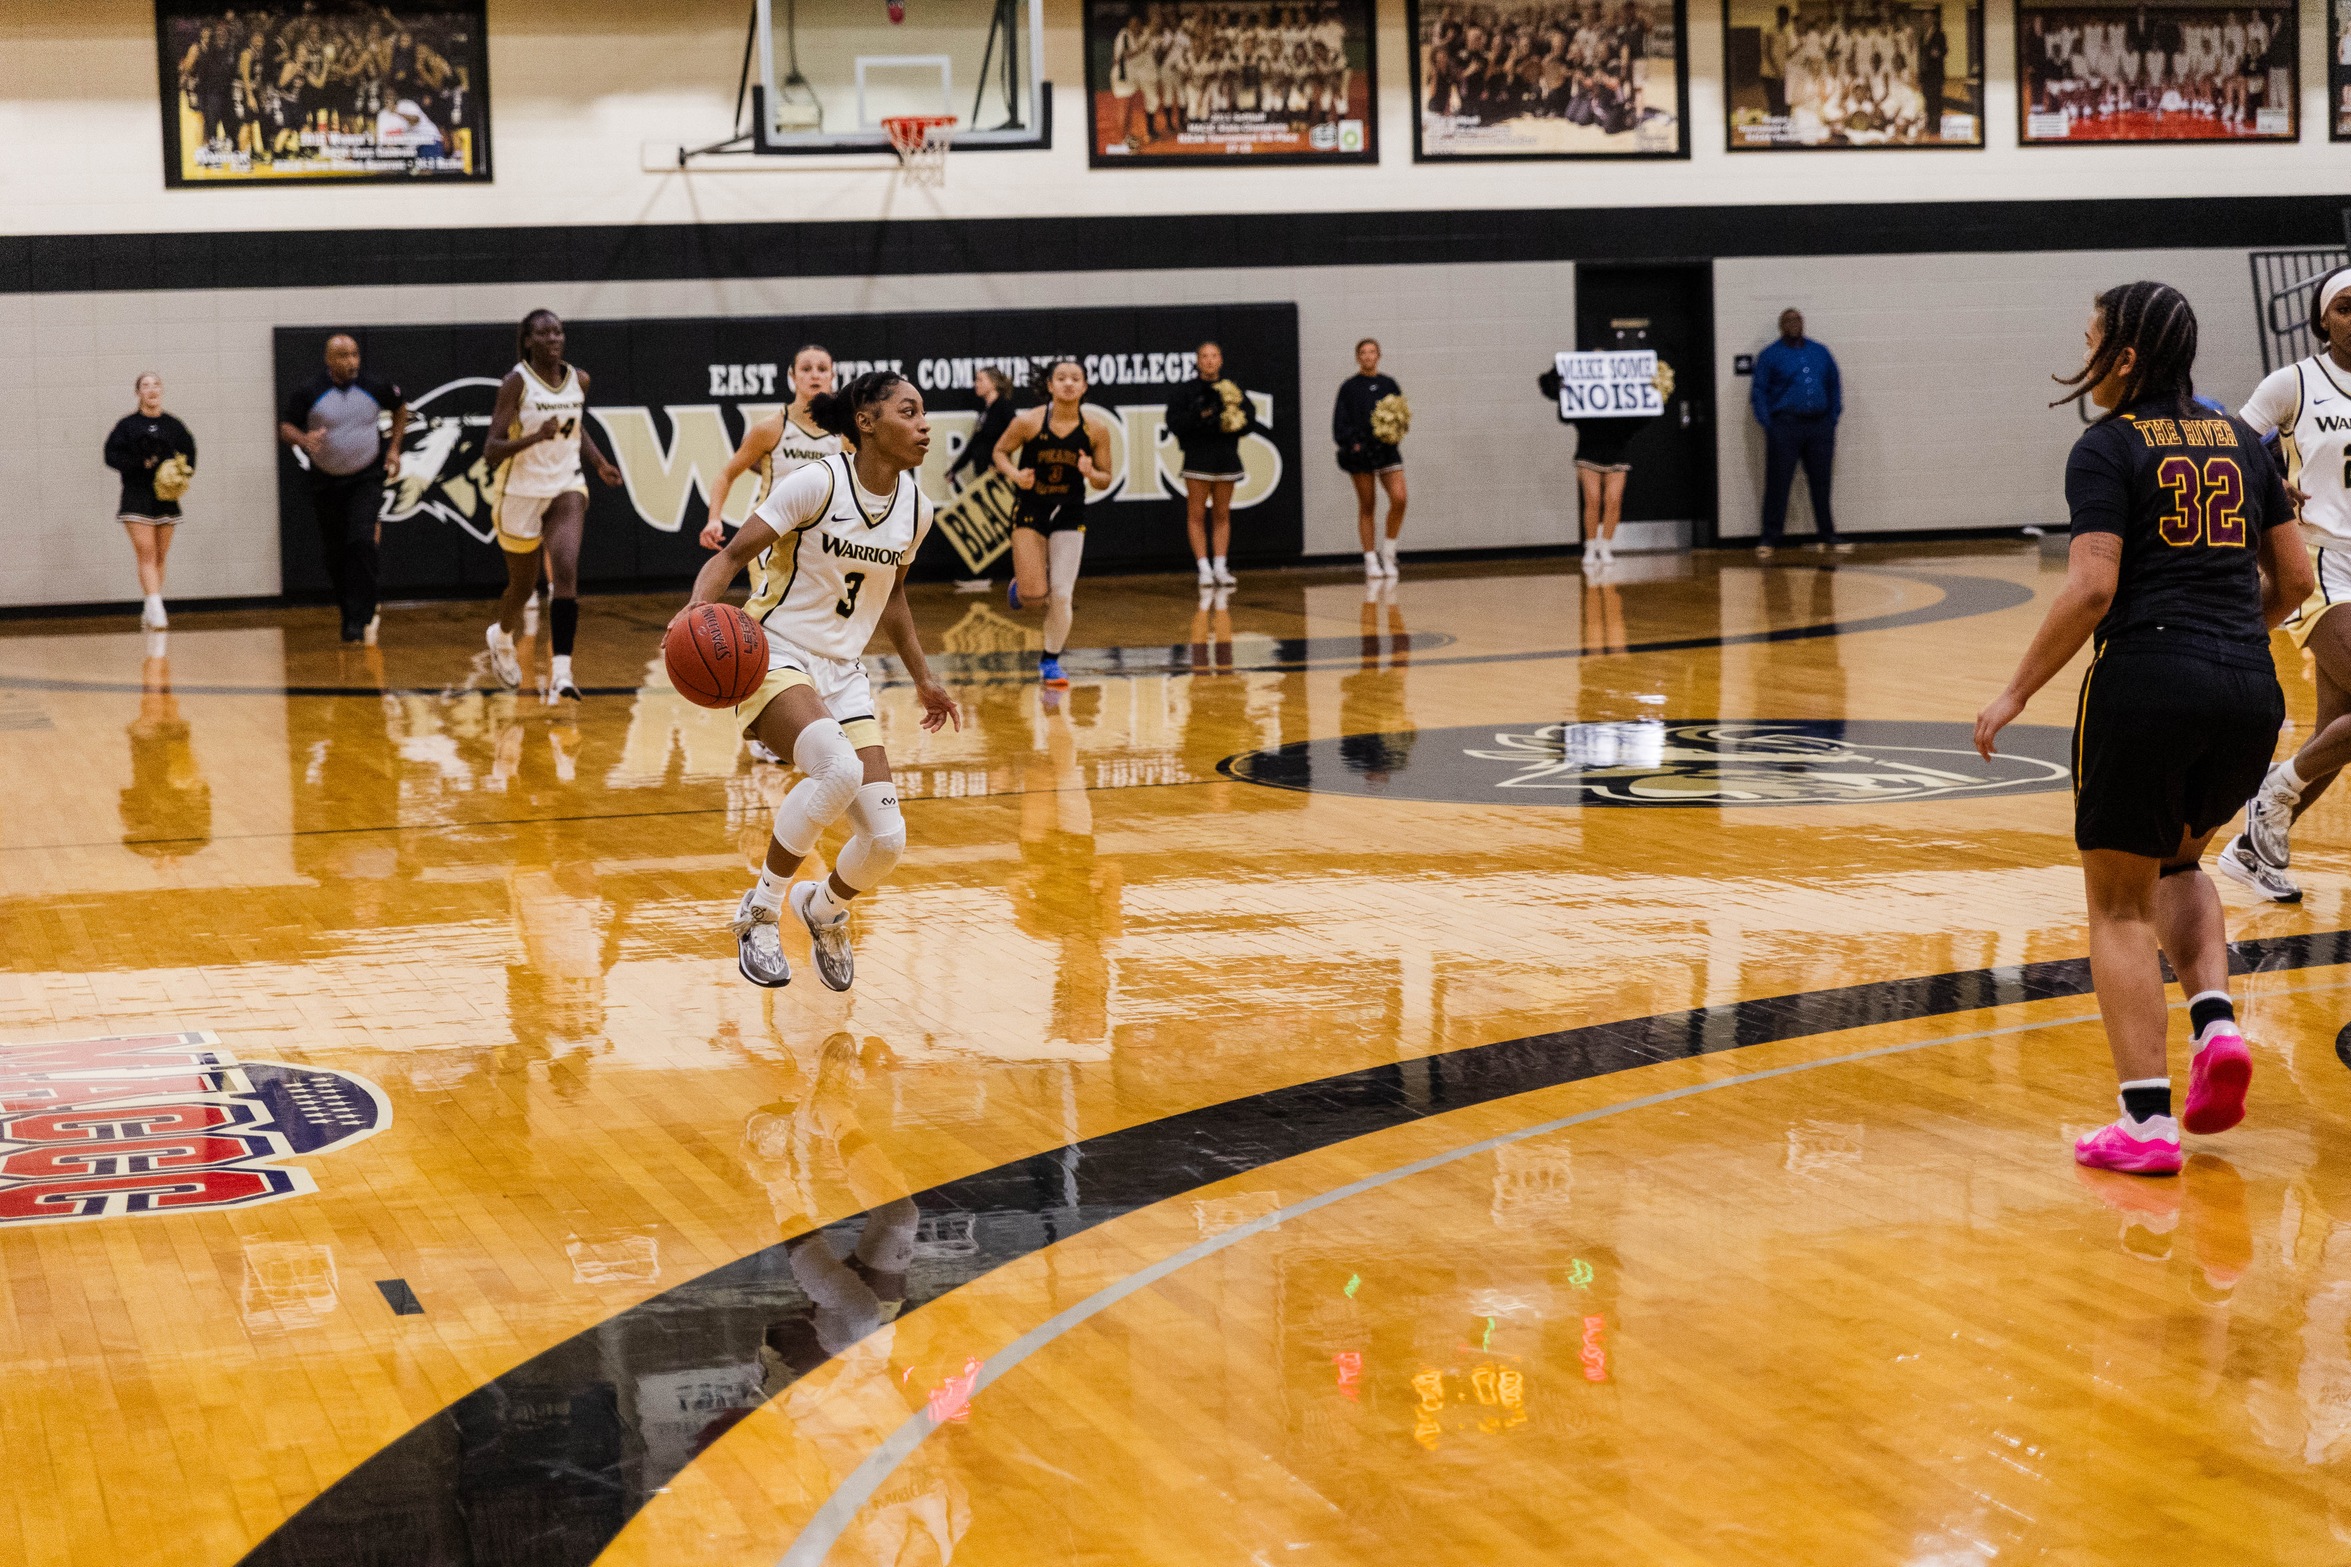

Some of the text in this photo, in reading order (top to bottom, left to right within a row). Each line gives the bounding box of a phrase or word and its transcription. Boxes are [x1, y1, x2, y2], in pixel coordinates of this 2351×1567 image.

[708, 362, 778, 397] EAST
[1084, 352, 1199, 386] COLLEGE
[1562, 356, 1653, 380] MAKE SOME
[1567, 382, 1658, 411] NOISE
[2132, 418, 2239, 447] THE RIVER
[2314, 415, 2351, 433] WA
[2156, 456, 2247, 548] 32
[835, 571, 866, 620] 3
